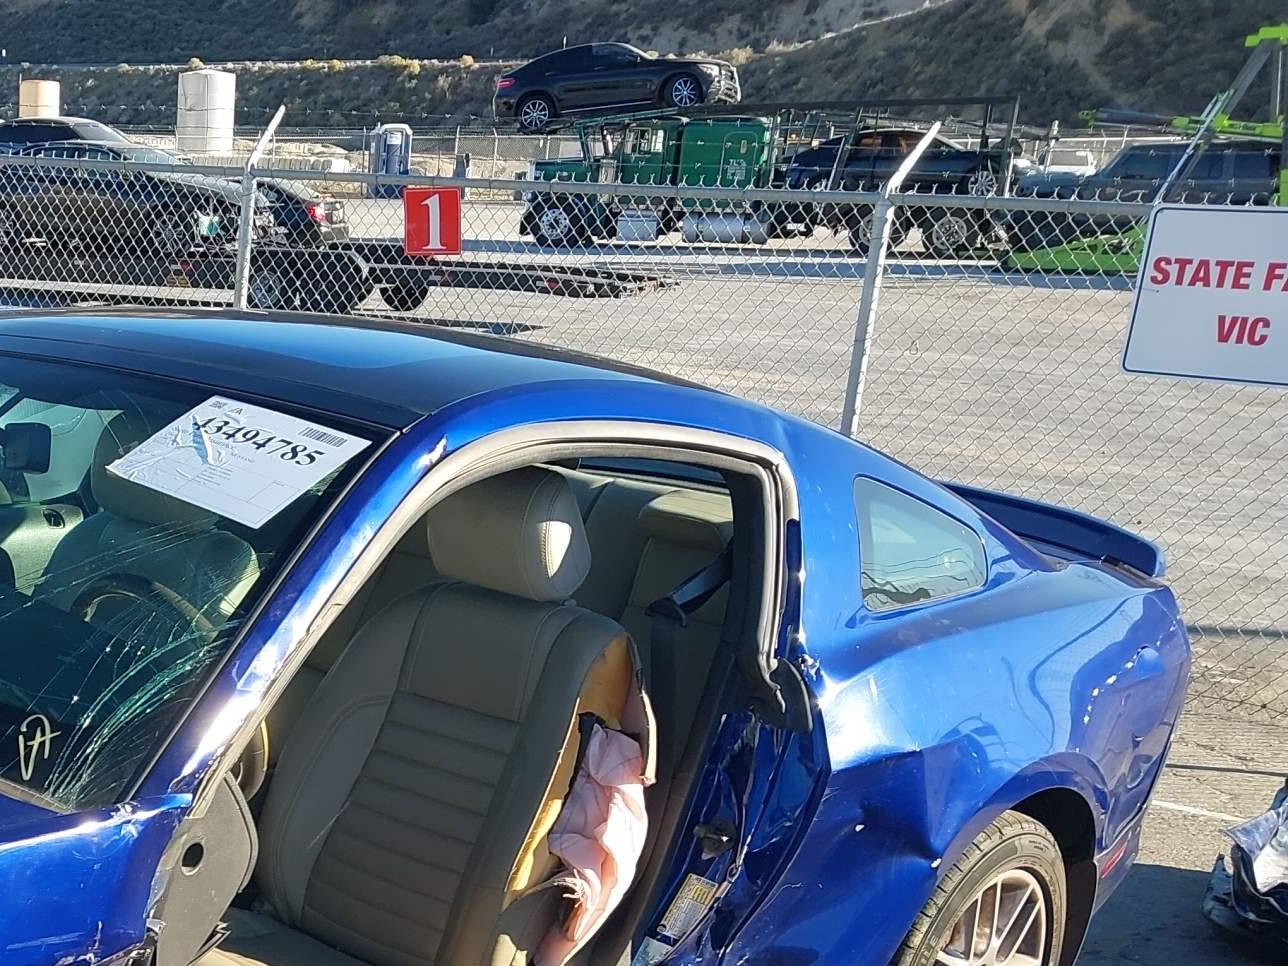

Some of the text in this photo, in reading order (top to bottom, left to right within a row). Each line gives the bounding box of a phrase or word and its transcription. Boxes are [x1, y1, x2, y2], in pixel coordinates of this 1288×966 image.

[420, 193, 447, 250] 1
[1150, 256, 1255, 290] STATE
[1217, 314, 1271, 346] VIC
